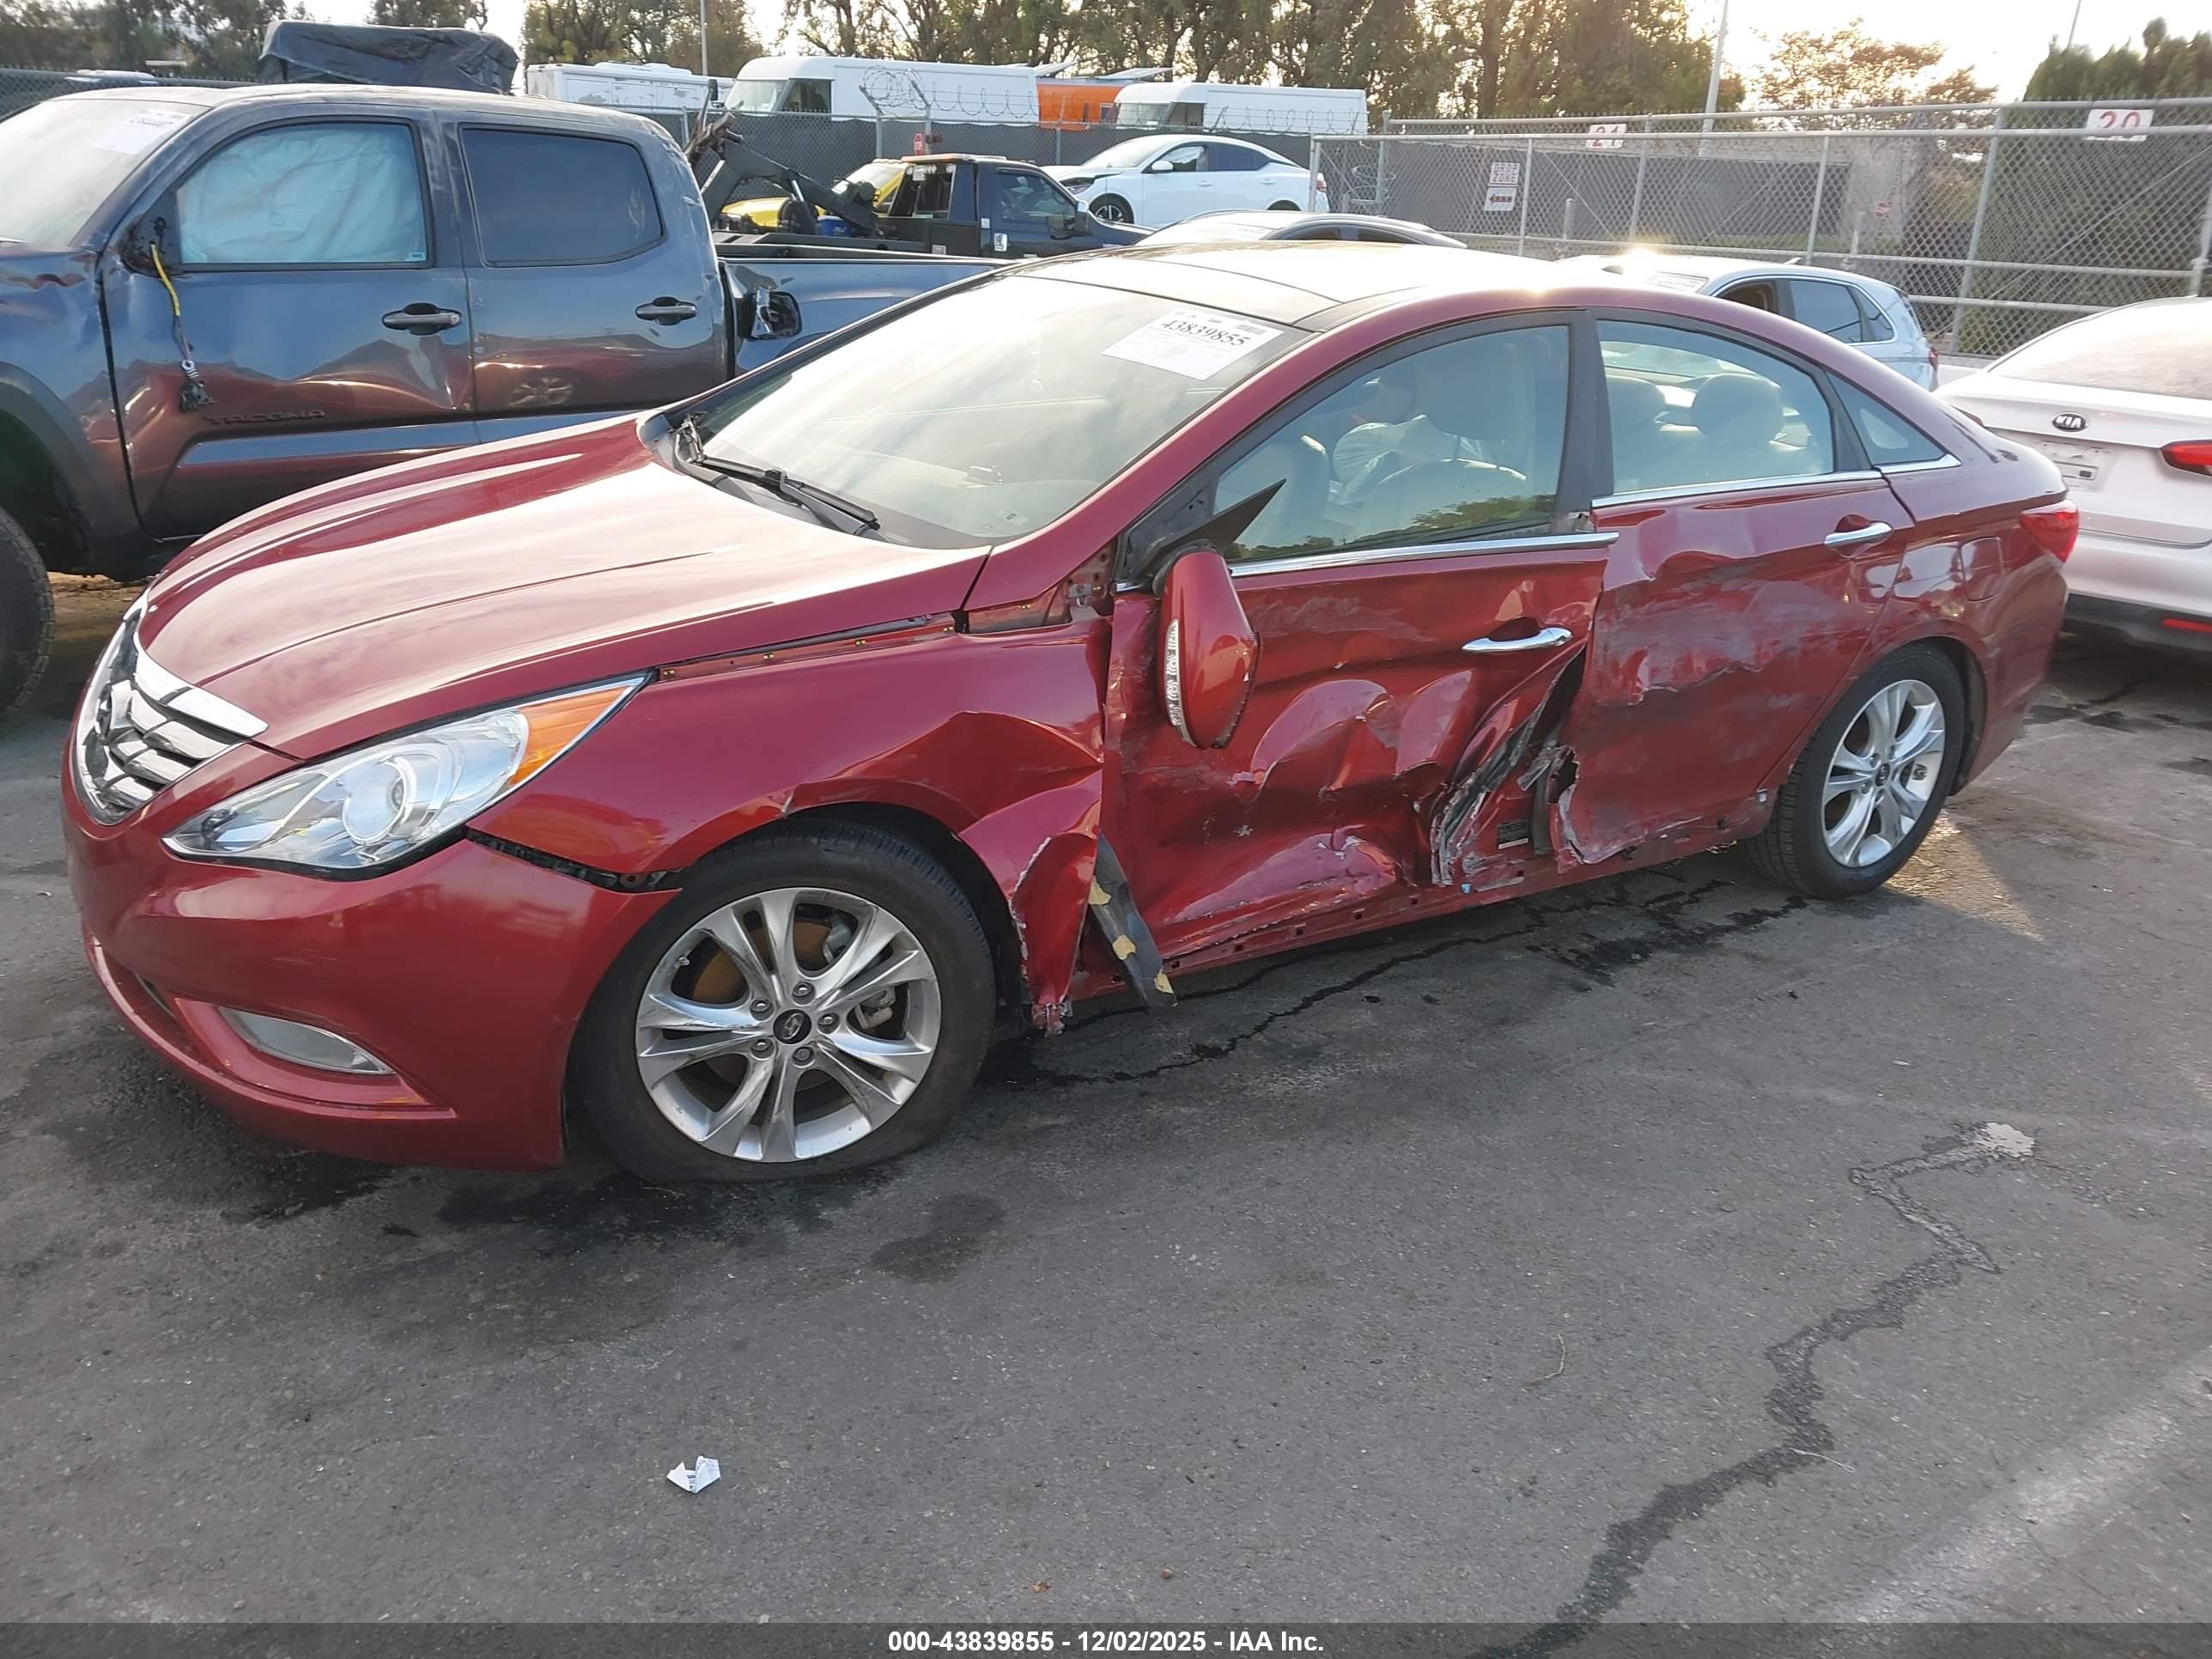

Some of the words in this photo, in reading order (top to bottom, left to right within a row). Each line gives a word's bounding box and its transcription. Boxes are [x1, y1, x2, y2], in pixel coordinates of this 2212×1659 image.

[2095, 110, 2140, 138] 20
[1591, 125, 1620, 147] 21
[1494, 162, 1518, 173] DROP
[1492, 173, 1517, 183] ZONE
[1162, 319, 1250, 347] 43839855
[203, 410, 326, 426] TACOMA
[2053, 415, 2081, 428] KIA
